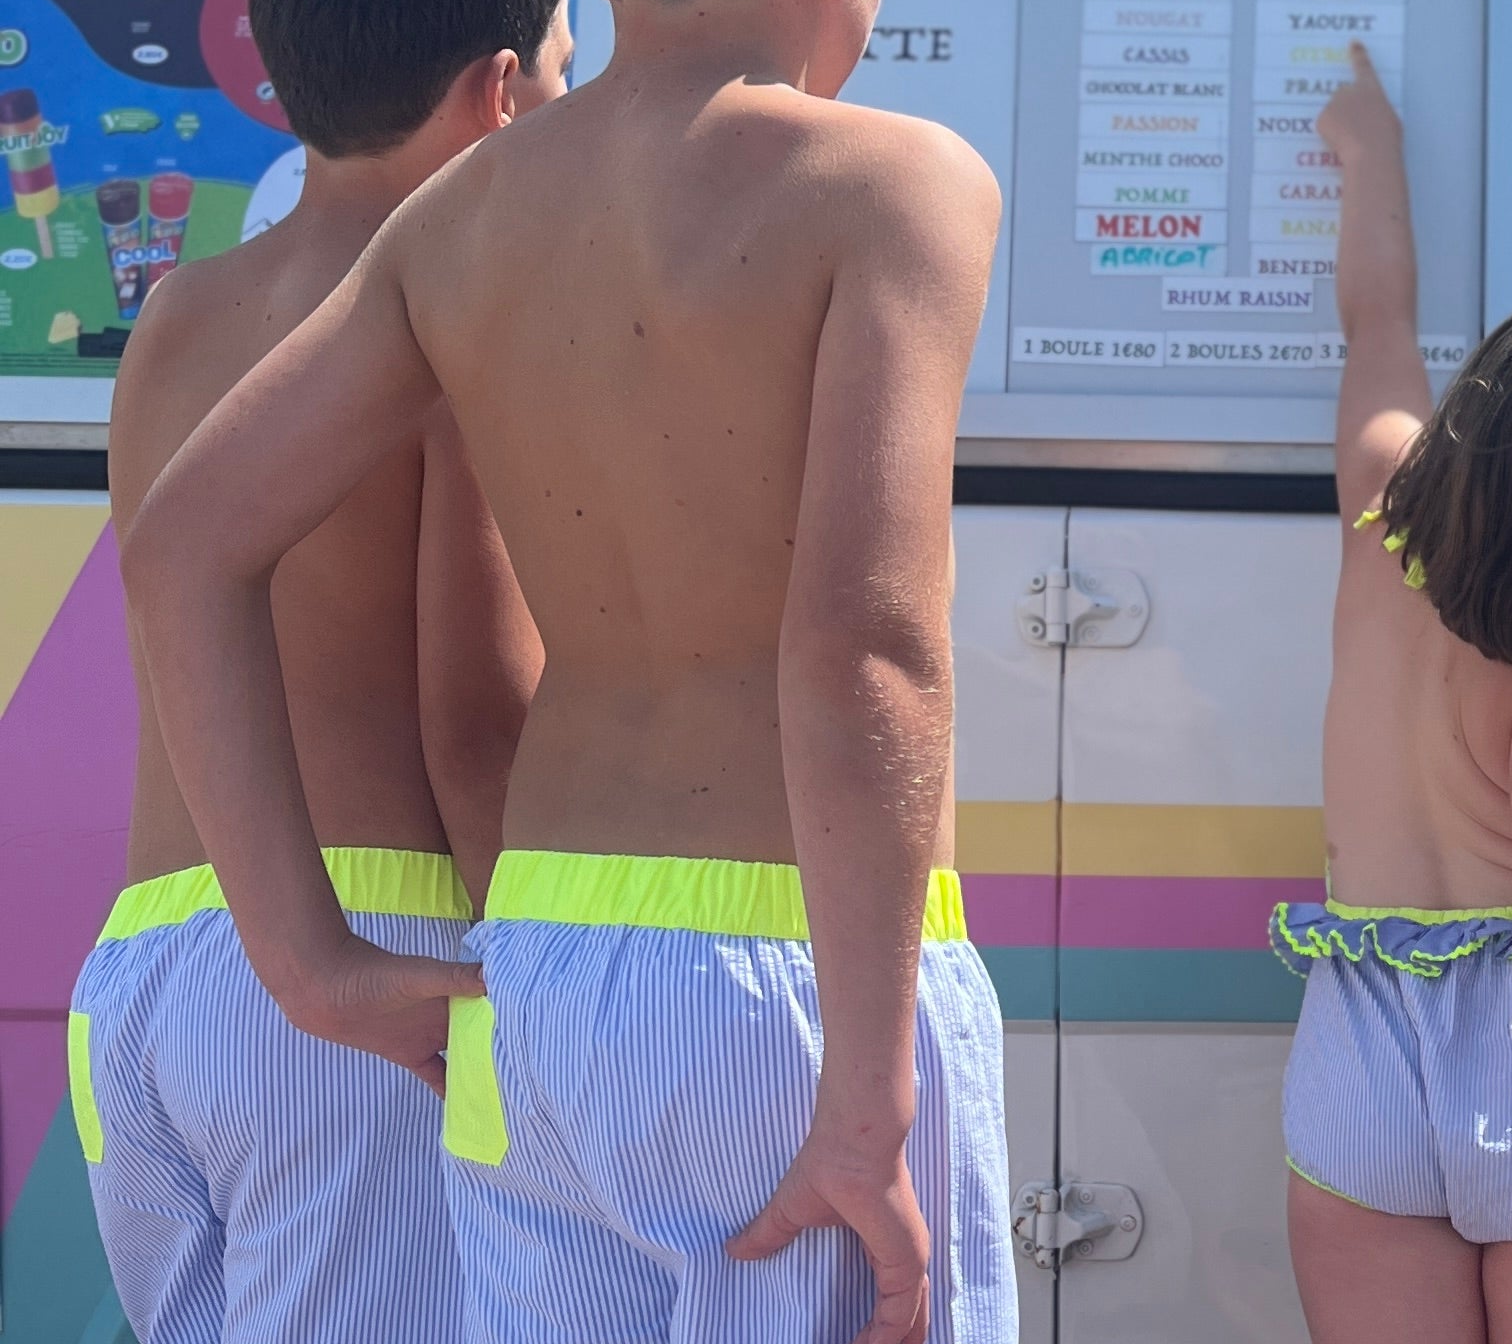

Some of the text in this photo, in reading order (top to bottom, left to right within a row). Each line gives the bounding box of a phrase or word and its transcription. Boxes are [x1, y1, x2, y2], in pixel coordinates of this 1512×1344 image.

[1115, 9, 1205, 28] NOUGAT
[1287, 13, 1377, 32] YAOURT
[862, 27, 953, 62] TTE
[1122, 47, 1190, 64] CASSIS
[1085, 80, 1169, 96] CHOCOLAT
[1111, 115, 1199, 133] PASSION
[1258, 118, 1314, 134] NOIX
[1082, 150, 1224, 168] MENTHE CHOCO
[1113, 186, 1191, 204] POMME
[1095, 213, 1203, 239] MELON
[1280, 219, 1339, 236] BANA
[1167, 290, 1313, 307] RHUM RAISIN
[1024, 339, 1033, 354] 1
[1040, 340, 1105, 356] BOULE
[1112, 342, 1156, 359] 1€80
[1170, 343, 1180, 358] 2
[1187, 344, 1263, 360] BOULES
[1269, 345, 1313, 361] 2€70
[1322, 344, 1331, 359] 3
